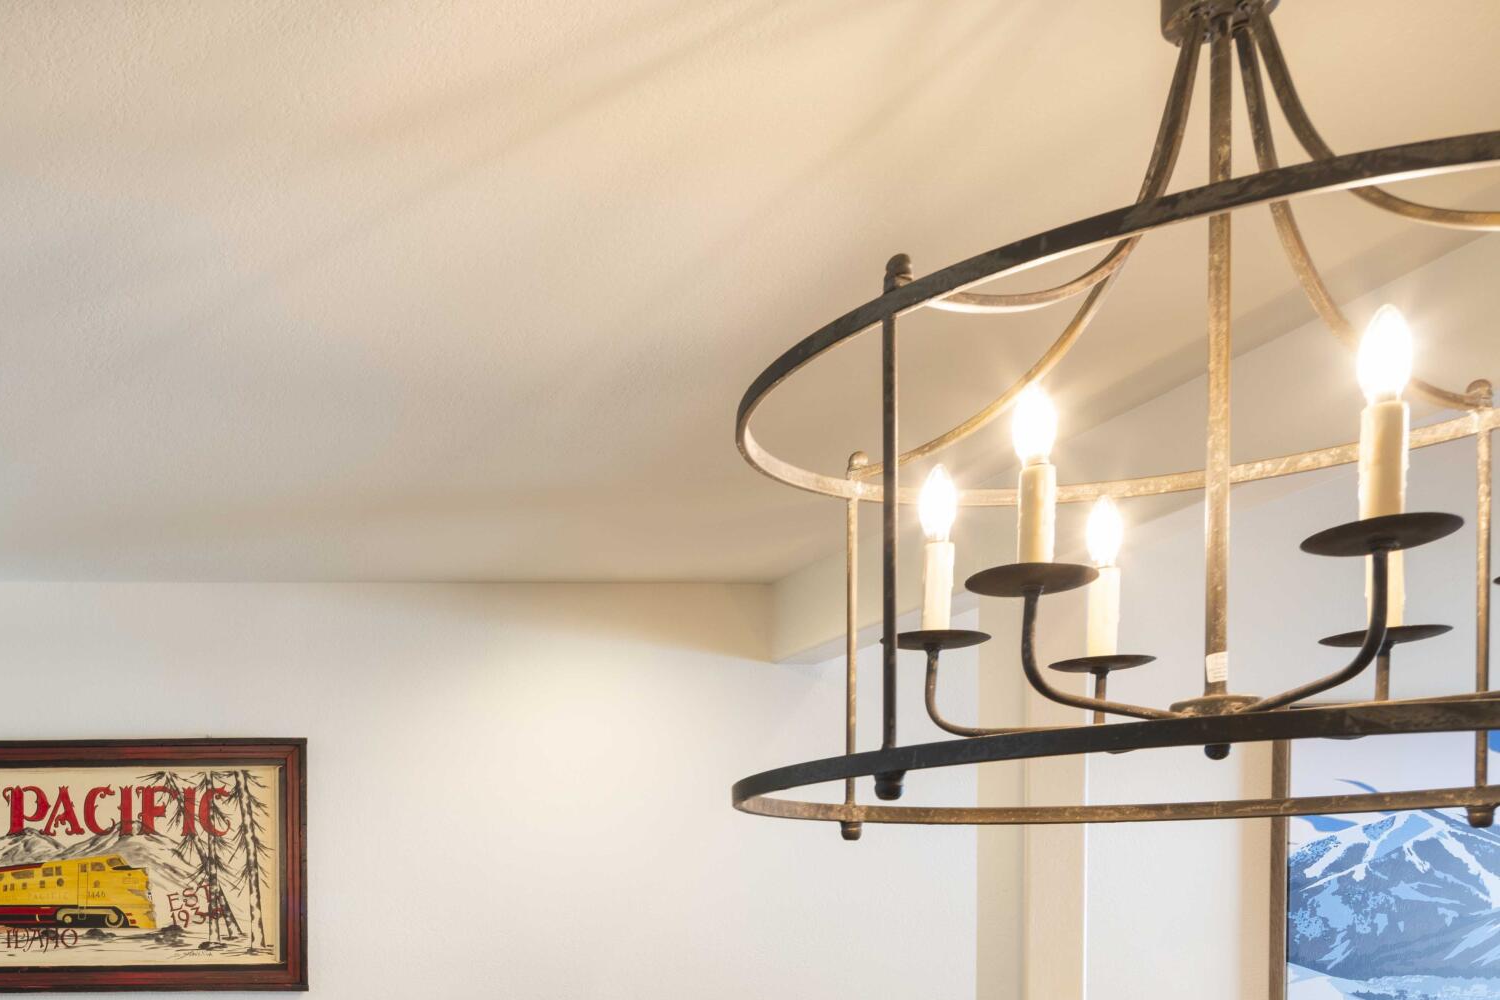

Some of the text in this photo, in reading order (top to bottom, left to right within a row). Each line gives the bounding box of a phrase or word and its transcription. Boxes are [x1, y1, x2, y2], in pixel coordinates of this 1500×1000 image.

[2, 785, 232, 838] PACIFIC
[166, 881, 213, 912] EST
[6, 927, 79, 953] IDAHO
